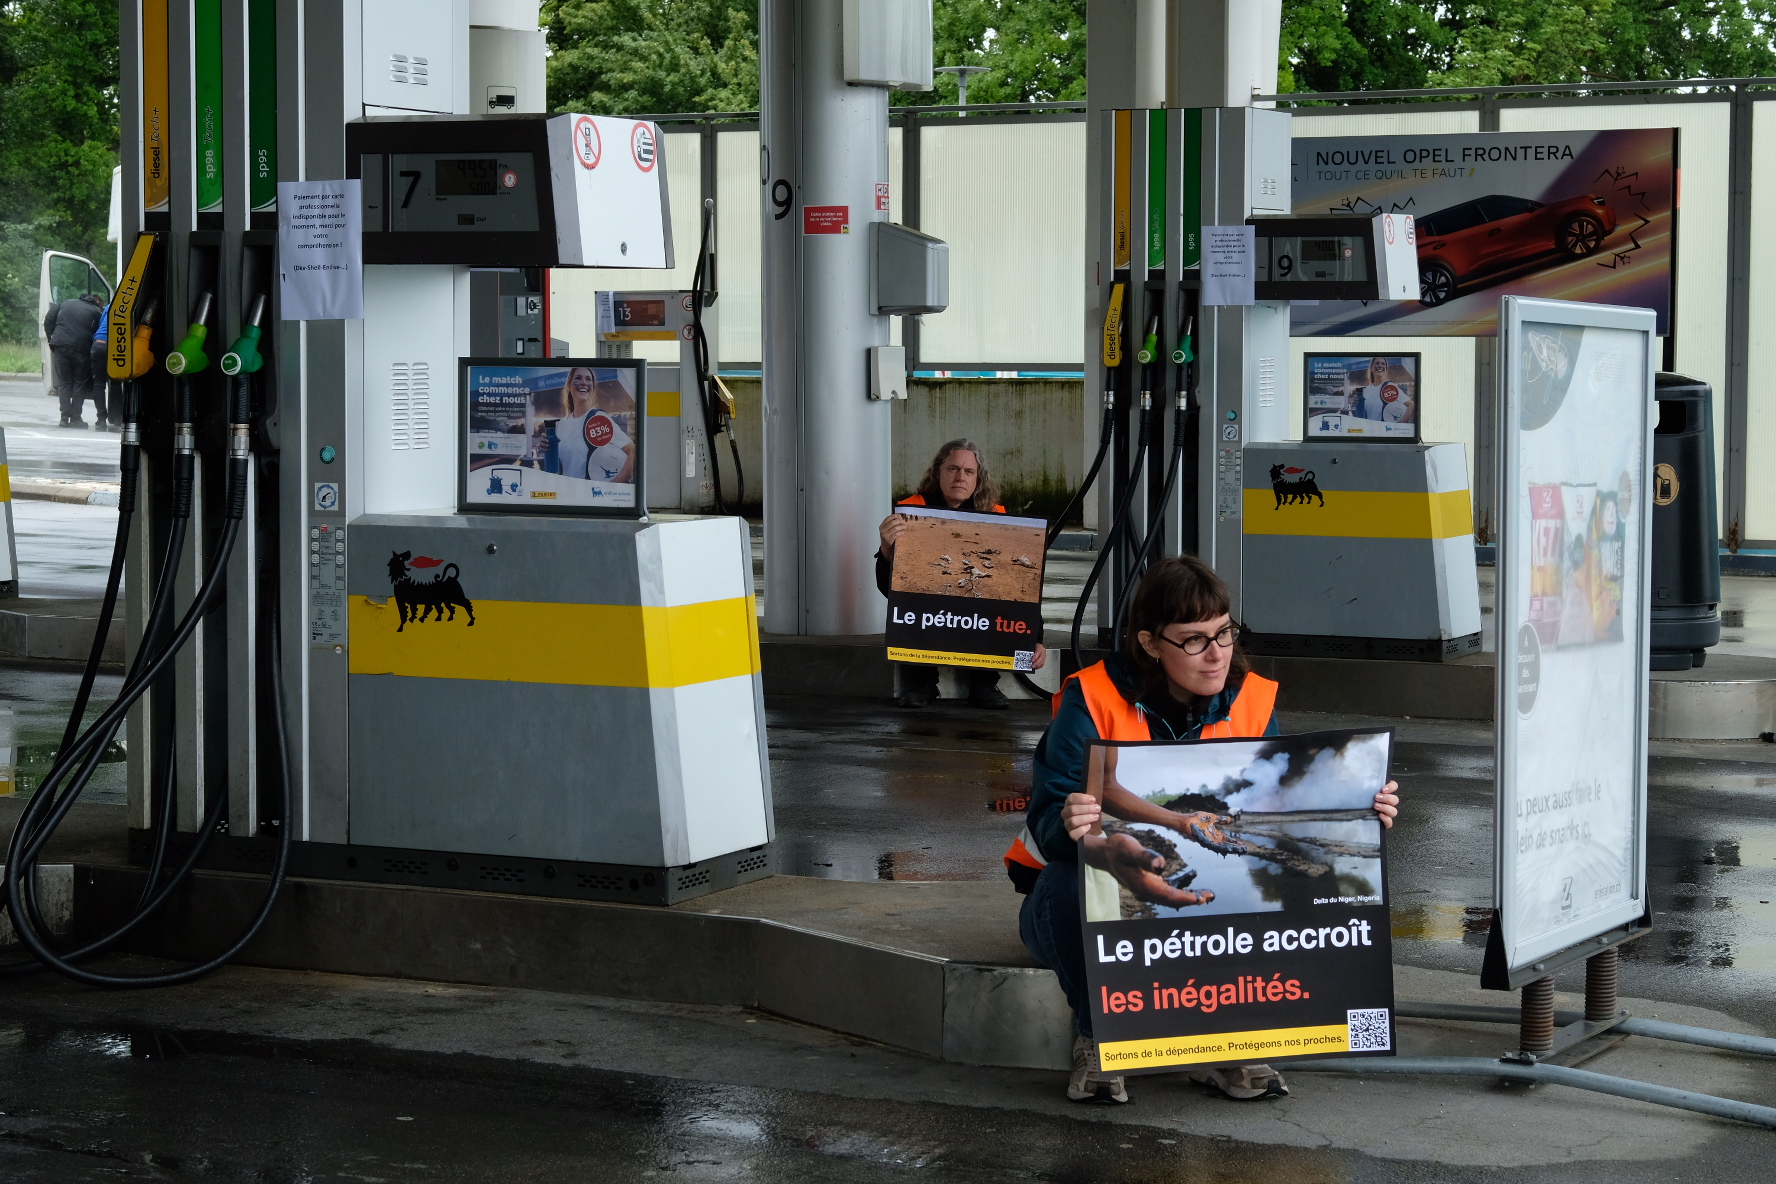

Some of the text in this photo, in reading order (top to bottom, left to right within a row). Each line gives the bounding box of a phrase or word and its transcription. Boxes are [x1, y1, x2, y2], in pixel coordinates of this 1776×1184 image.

[150, 106, 160, 179] diesel Tech+
[203, 105, 216, 179] sp98 Tech+
[1316, 144, 1574, 166] NOUVEL OPEL FRONTERA
[258, 149, 269, 178] sp95
[1316, 167, 1465, 181] TOUT CE QU'IL TE FAUT
[400, 170, 421, 209] 7
[772, 178, 793, 220] 9
[1153, 233, 1161, 251] sp98
[1188, 233, 1196, 250] sp95
[1277, 254, 1293, 278] 9
[113, 275, 138, 367] diesel Tech+
[618, 307, 632, 321] 13
[1106, 306, 1119, 360] diesel Tech+
[478, 386, 530, 394] commence
[479, 375, 522, 384] Le match
[478, 395, 501, 403] chez
[589, 424, 610, 438] 83%
[892, 606, 1031, 634] Le pétrole tue.
[1517, 777, 1601, 822] u peux aussi faire le
[1516, 813, 1592, 854] lein de snacks ici.
[1313, 897, 1329, 905] Delta
[1338, 895, 1356, 903] Niger,
[1357, 894, 1380, 902] Nigeria
[1097, 918, 1372, 967] Le pétrole accroît
[1101, 972, 1310, 1014] les inégalités.
[1104, 1034, 1345, 1062] Sortons de la dépendance. Protégeons nos proches.
